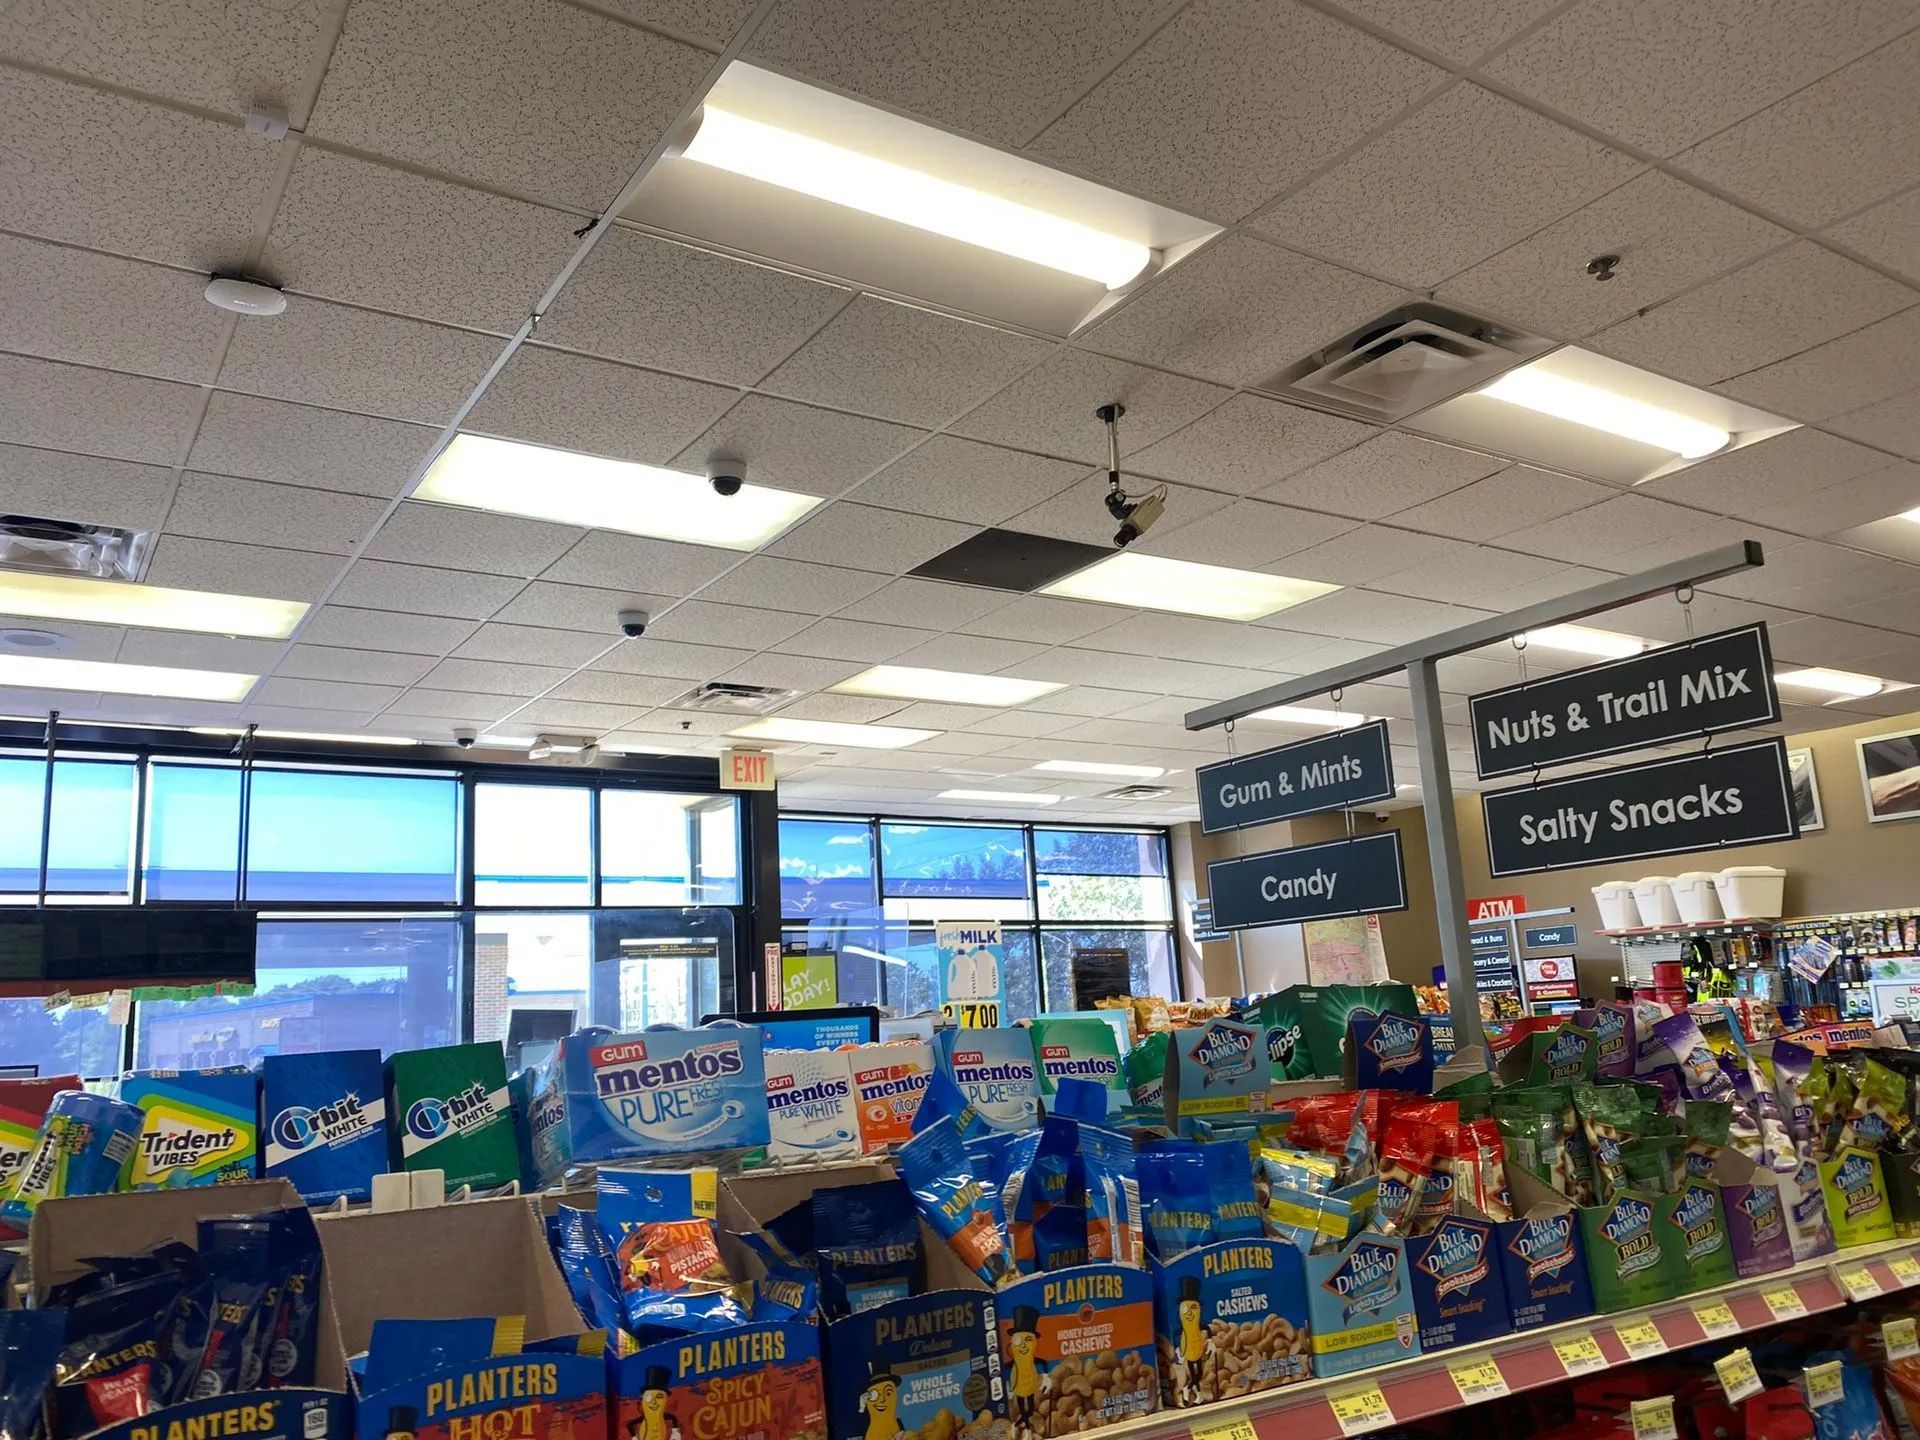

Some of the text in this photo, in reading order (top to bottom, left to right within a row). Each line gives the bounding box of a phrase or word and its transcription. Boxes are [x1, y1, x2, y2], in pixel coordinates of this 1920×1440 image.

[1488, 665, 1752, 749] Nuts & Trail Mix
[733, 755, 766, 783] EXIT
[1219, 755, 1362, 808] Gum & Mints
[1519, 784, 1743, 845] Salty Snacks
[1261, 867, 1337, 902] Candy
[1478, 899, 1514, 919] ATM
[960, 930, 998, 944] MILK
[1470, 935, 1484, 945] read
[1539, 932, 1560, 942] Candy
[783, 969, 810, 993] LAY
[783, 978, 832, 1009] ODAY!
[816, 1024, 859, 1032] THOUSANDS
[1208, 1029, 1234, 1048] BLUE
[1381, 1021, 1407, 1038] BLUE
[1828, 1025, 1872, 1043] mentos
[816, 1039, 839, 1047] EVERY
[1199, 1035, 1250, 1064] DIAMOND
[1269, 1025, 1302, 1060] lipse
[1373, 1027, 1418, 1053] DIAMOND
[1547, 1039, 1587, 1062] DIAMOND
[1557, 1034, 1575, 1047] BLUE
[1601, 1038, 1622, 1053] BOLD
[601, 1043, 644, 1062] GUM
[957, 1053, 981, 1063] GUM
[1046, 1048, 1069, 1057] GUM
[598, 1049, 741, 1096] mentos
[861, 1069, 885, 1081] GUM
[956, 1063, 1033, 1083] mentos
[1045, 1058, 1117, 1075] mentos
[1553, 1064, 1579, 1079] BOLD
[767, 1076, 792, 1089] GUM
[969, 1084, 1008, 1104] PURE
[767, 1081, 848, 1110] mentos
[405, 1086, 489, 1140] Orbit
[452, 1102, 494, 1129] WHITE
[621, 1089, 692, 1128] PURE
[779, 1100, 844, 1121] PURE WHITE
[271, 1097, 363, 1150] Orbit
[322, 1114, 367, 1140] WHITE
[141, 1128, 234, 1153] Trident
[22, 1130, 57, 1194] Trident
[153, 1150, 198, 1166] VIBES
[36, 1158, 57, 1190] VIBES
[217, 1168, 248, 1182] SOUR
[694, 1200, 715, 1211] NEW!
[1615, 1201, 1639, 1221] BLUE
[1676, 1194, 1714, 1226] DIAMOND
[1685, 1190, 1705, 1209] BLUE
[1530, 1218, 1555, 1237] BLUE
[1606, 1206, 1650, 1240] DIAMOND
[1757, 1209, 1777, 1229] BOLD
[1439, 1228, 1467, 1251] BLUE
[1519, 1219, 1569, 1256] DIAMOND
[1690, 1222, 1714, 1244] BOLD
[832, 1242, 916, 1268] PLANTERS
[1428, 1233, 1482, 1273] DIAMOND
[1622, 1236, 1649, 1260] BOLD
[1203, 1246, 1273, 1278] PLANTERS
[1350, 1247, 1382, 1273] BLUE
[1529, 1251, 1573, 1277] Smokehouse
[1336, 1252, 1397, 1295] DIAMOND
[1437, 1267, 1486, 1296] Smokehouse
[1044, 1274, 1123, 1309] PLANTERS
[1231, 1286, 1252, 1297] SALTED
[1217, 1293, 1268, 1316] CASHEWS
[875, 1301, 975, 1345] PLANTERS
[1057, 1323, 1113, 1341] HONEY ROASTED
[1060, 1334, 1111, 1355] CASHEWS
[1326, 1326, 1383, 1347] LOW SODIUM
[679, 1331, 785, 1378] PLANTERS
[910, 1373, 953, 1392] WHOLE
[1479, 1366, 1498, 1378] $1.79
[426, 1363, 557, 1416] PLANTERS
[706, 1373, 766, 1405] SPICY
[903, 1382, 960, 1406] CASHEWS
[1362, 1393, 1383, 1407] $1.79
[131, 1401, 275, 1440] PLANTERS
[308, 1411, 324, 1424] 160
[449, 1404, 540, 1440] HOT
[693, 1395, 772, 1440] CAJUN
[1231, 1426, 1253, 1440] $1.79
